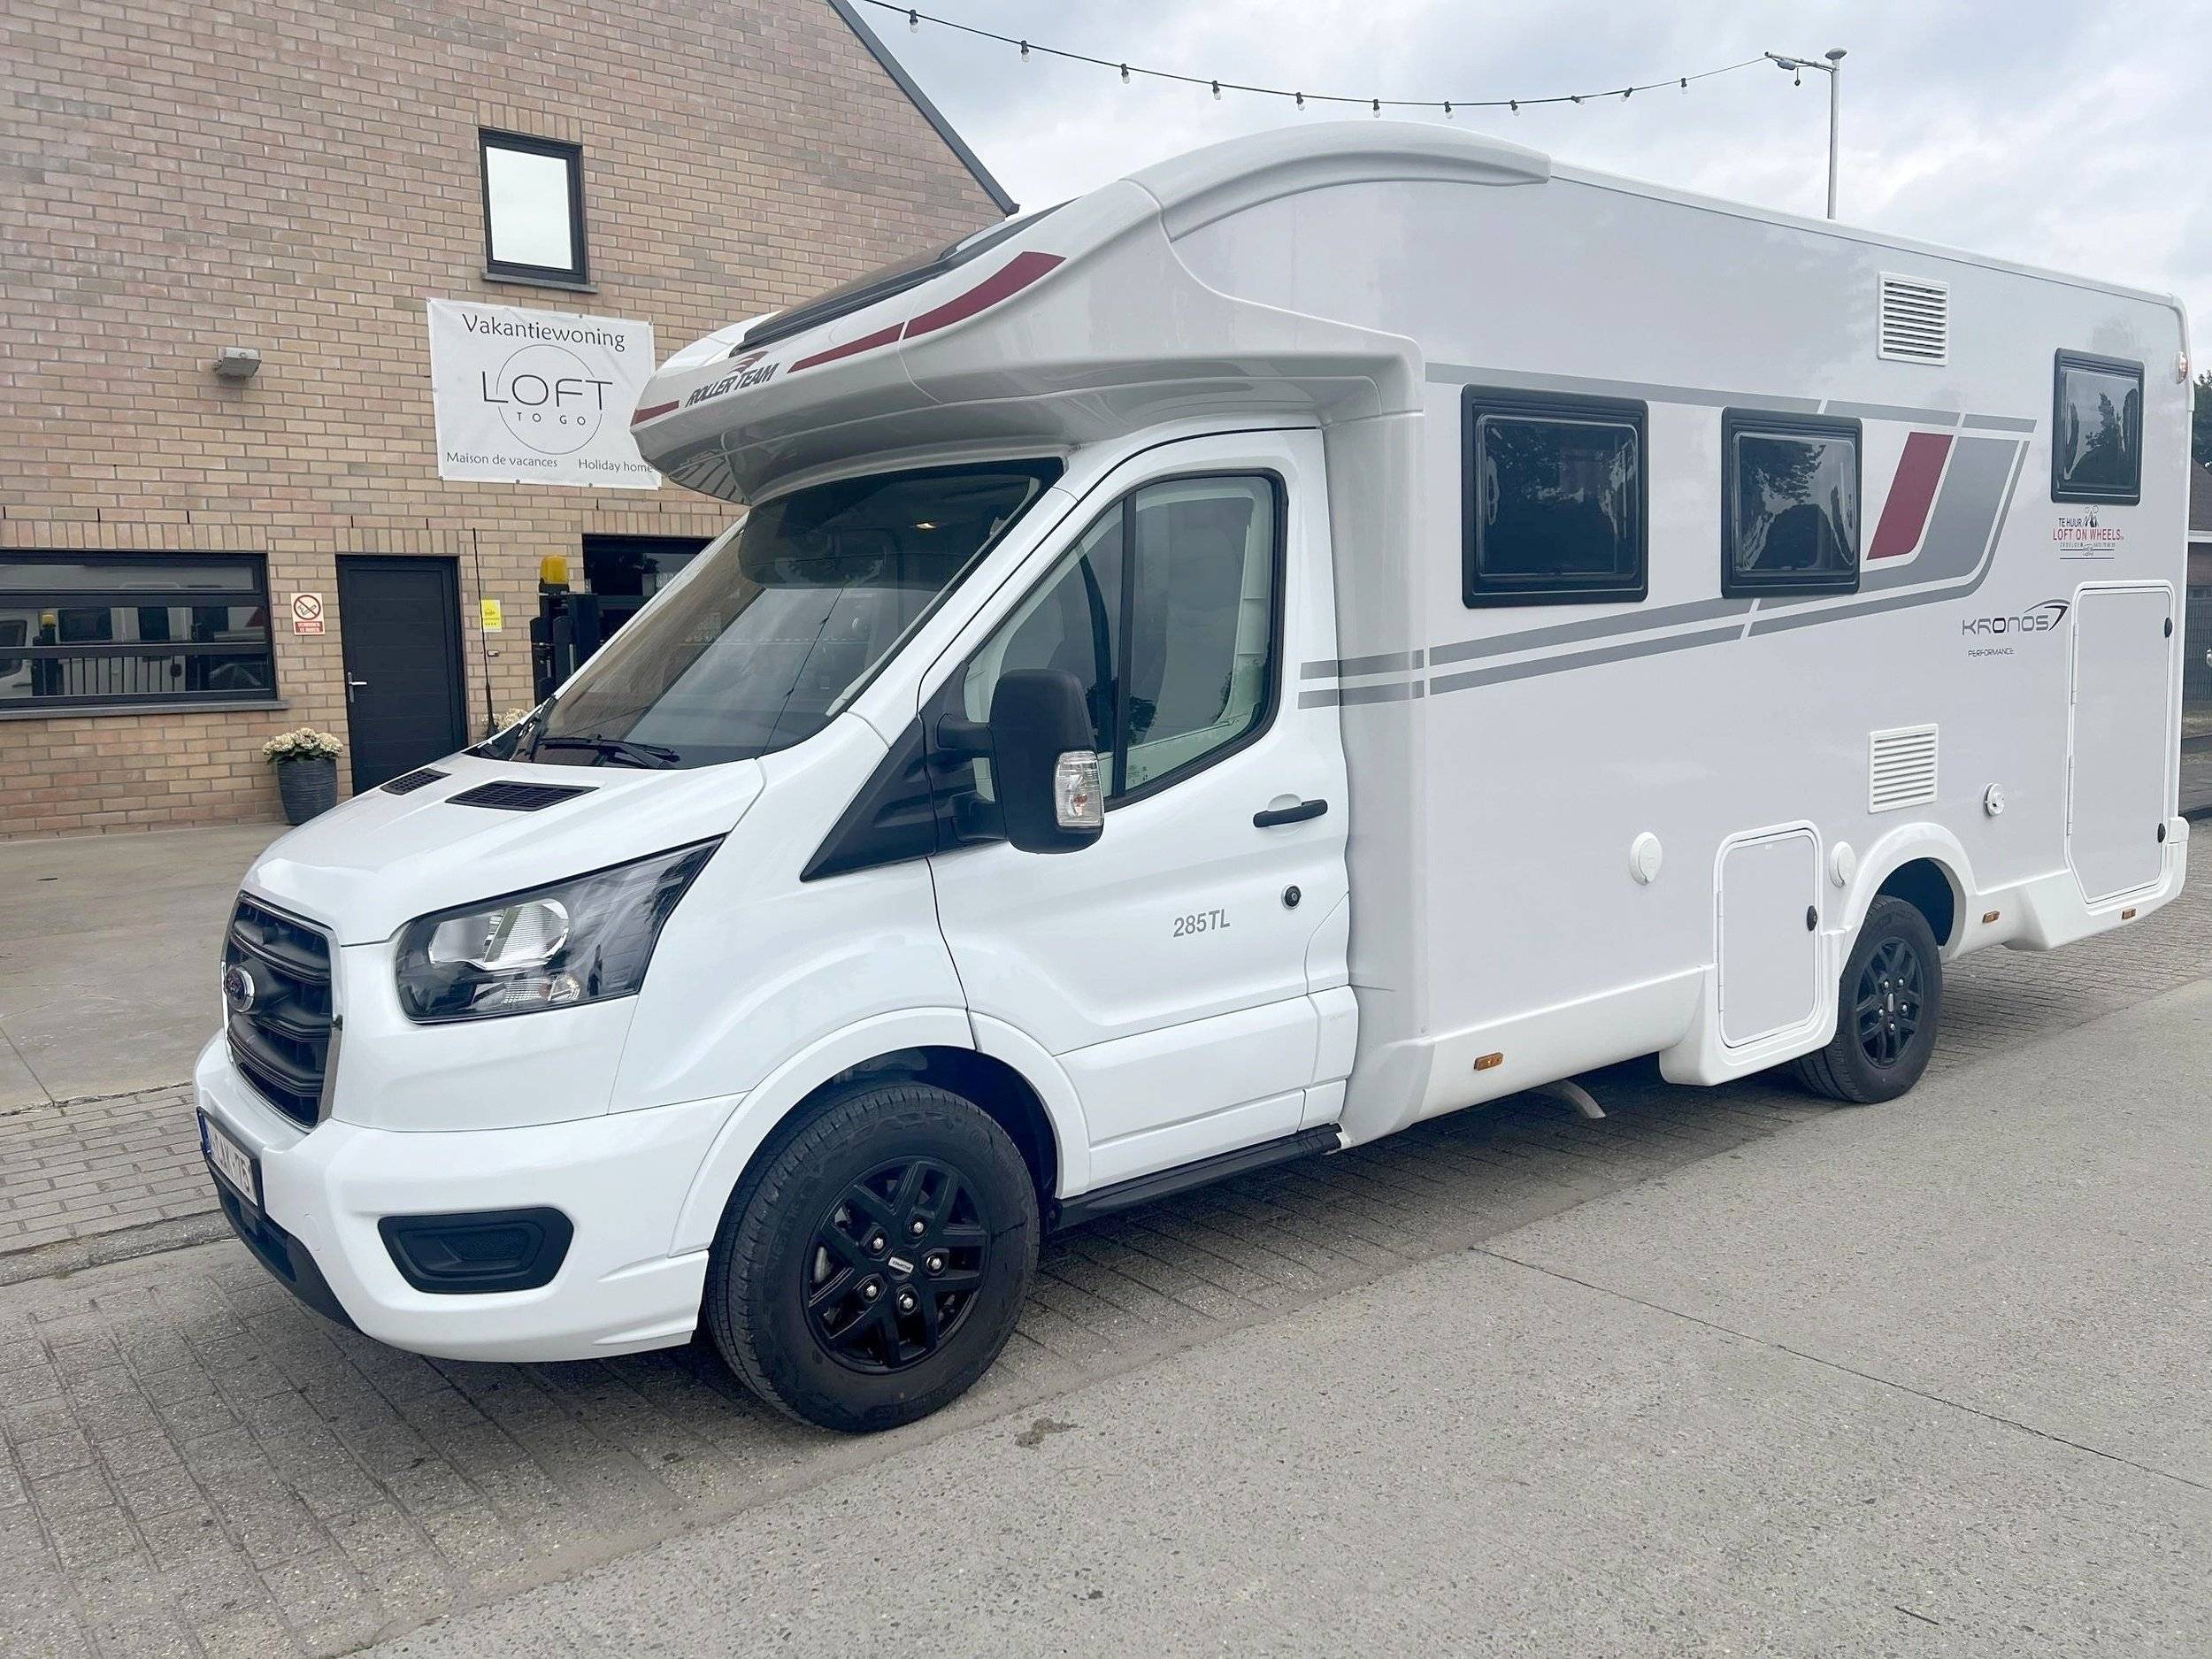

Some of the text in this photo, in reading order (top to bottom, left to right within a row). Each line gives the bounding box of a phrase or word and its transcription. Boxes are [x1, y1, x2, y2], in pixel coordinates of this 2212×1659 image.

[462, 313, 626, 353] Vakantiewoning
[482, 371, 613, 411] LOFT
[685, 362, 780, 409] ROLLER TEAM
[517, 411, 586, 426] TO GO
[446, 452, 558, 469] Maison de vacances
[578, 458, 653, 473] Holiday home
[2066, 518, 2083, 528] HUUR
[2053, 528, 2074, 541] LOFT
[2076, 528, 2088, 541] ON
[1962, 614, 2049, 636] KRONOS
[1968, 647, 2015, 657] PERFORMANCE
[1173, 908, 1231, 938] 285TL
